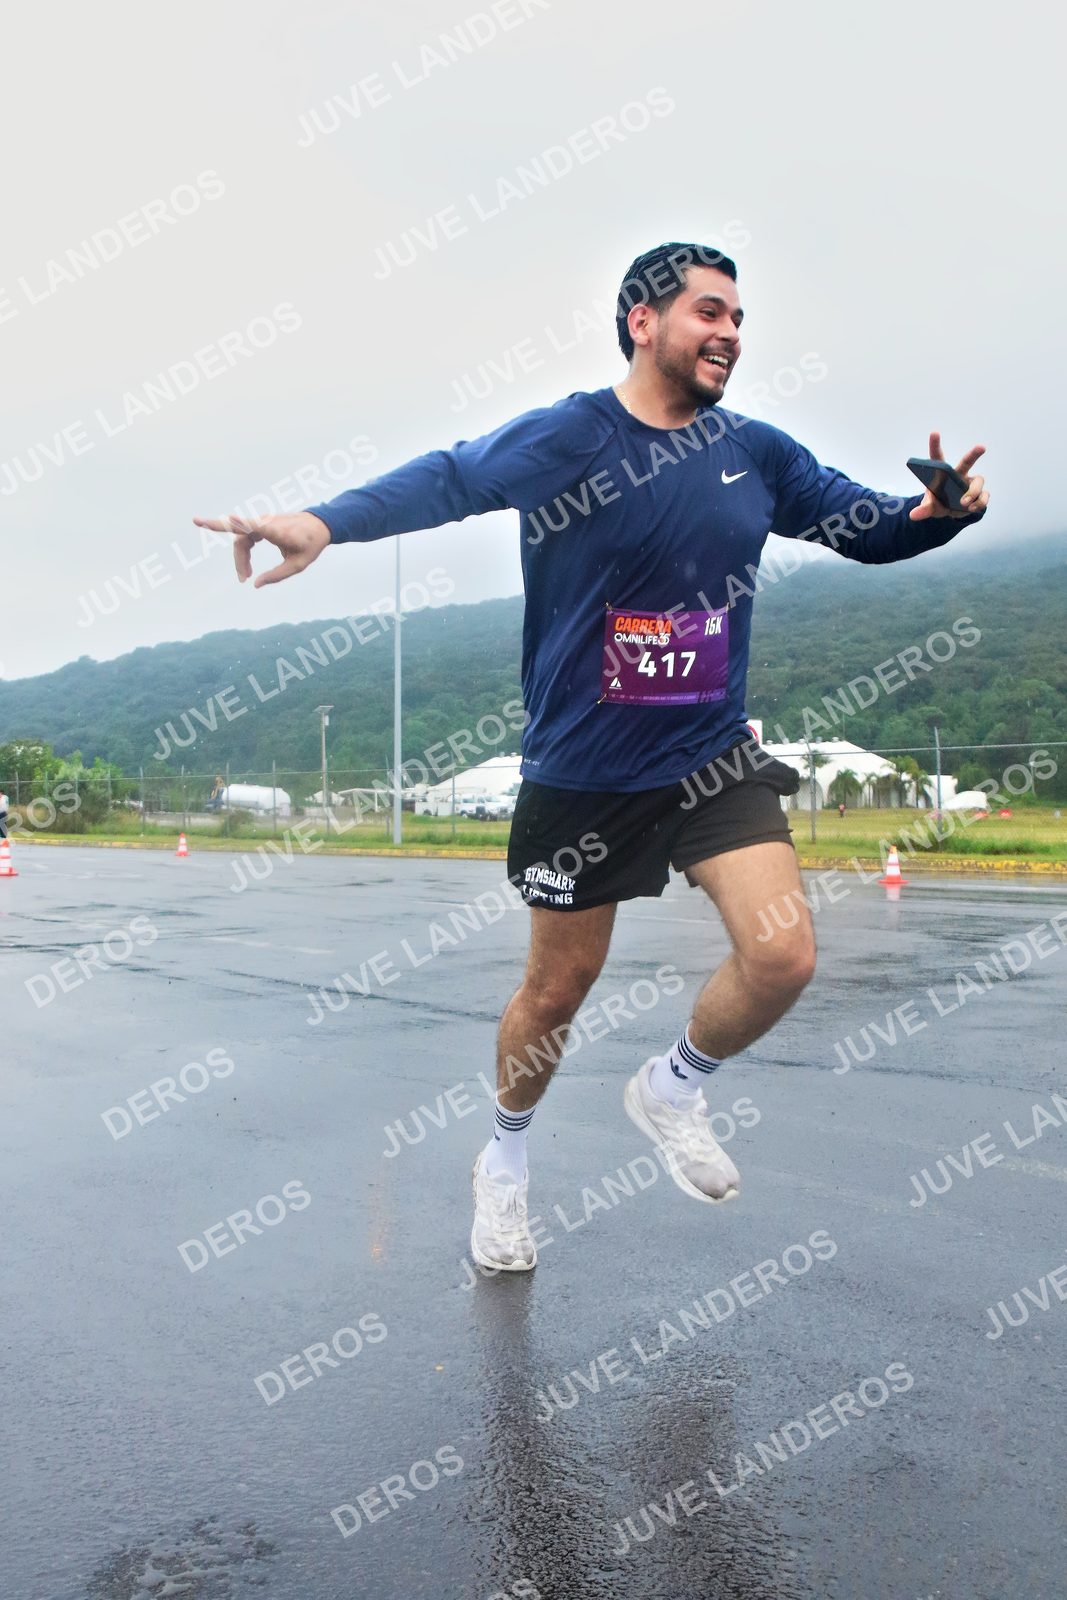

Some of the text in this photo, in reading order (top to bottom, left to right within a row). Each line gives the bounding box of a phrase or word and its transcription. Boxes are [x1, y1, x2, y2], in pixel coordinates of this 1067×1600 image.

[615, 616, 672, 635] CARRERA
[705, 616, 722, 635] 15K
[638, 651, 696, 678] 417
[525, 866, 576, 891] GYMSHARK
